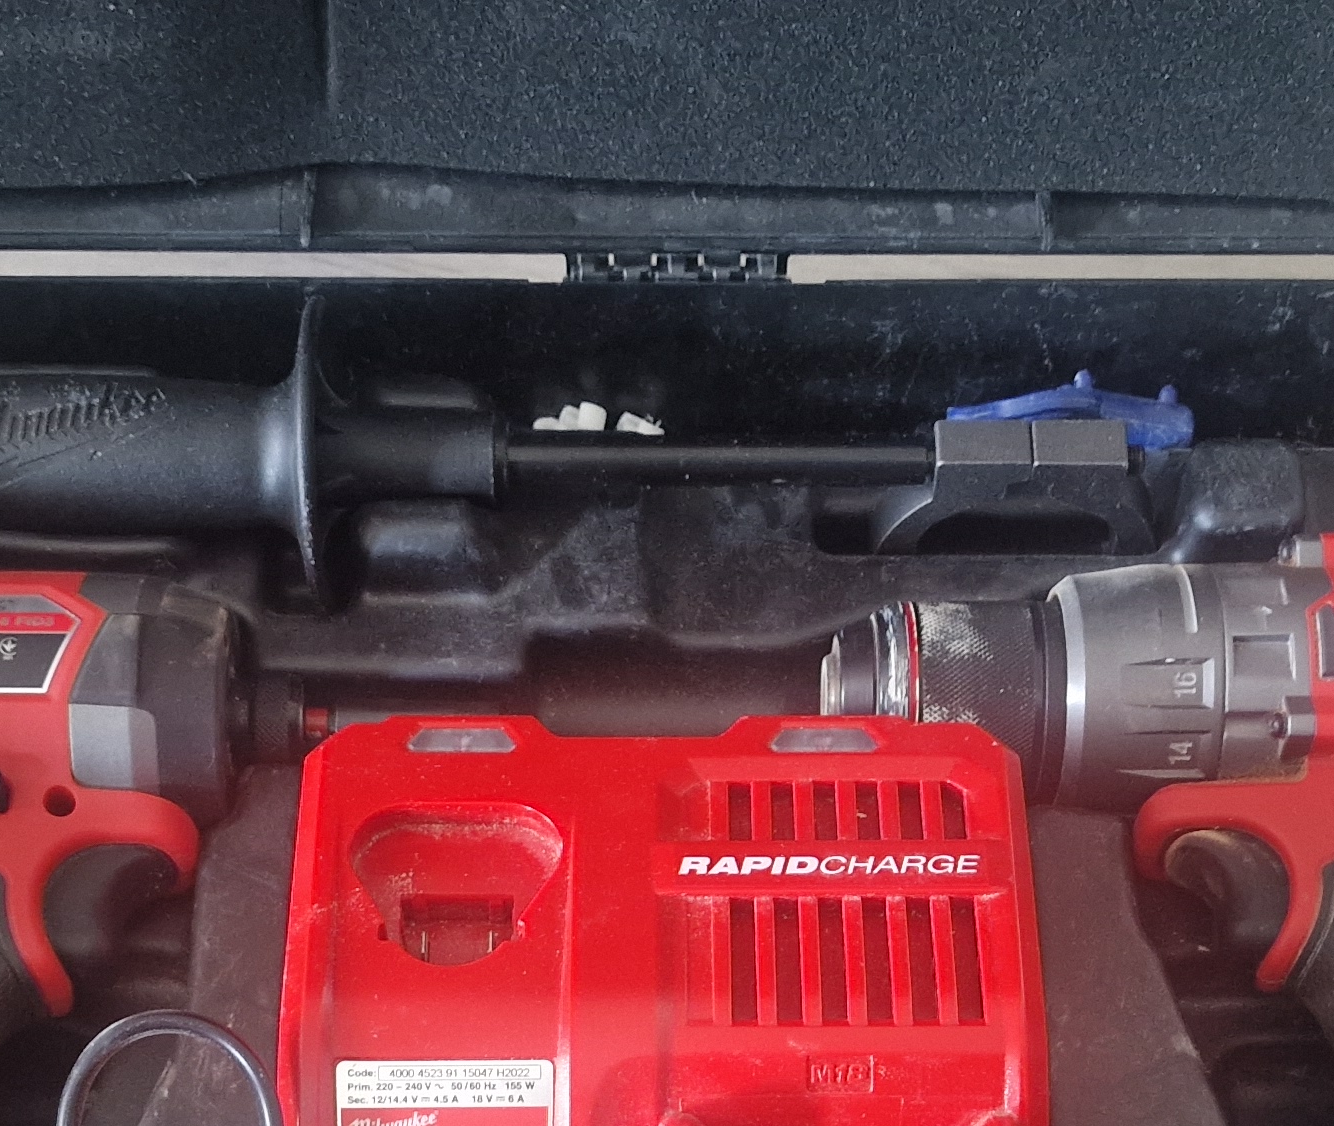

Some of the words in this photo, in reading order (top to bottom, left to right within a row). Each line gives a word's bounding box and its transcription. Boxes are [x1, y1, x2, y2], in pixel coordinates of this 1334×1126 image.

[1174, 671, 1197, 698] 16
[1168, 742, 1193, 765] 14
[678, 855, 981, 875] RAPIDCHARGE
[347, 1069, 376, 1077] Code:
[389, 1068, 415, 1078] 4000
[418, 1068, 443, 1078] 4523
[446, 1068, 458, 1078] 91
[462, 1068, 493, 1077] 15047
[496, 1068, 531, 1077] H2022
[347, 1083, 373, 1091] Prim.
[376, 1083, 394, 1091] 220
[405, 1083, 423, 1091] 240
[424, 1083, 431, 1091] V
[484, 1082, 497, 1090] Hz
[505, 1082, 523, 1090] 155
[525, 1081, 535, 1090] W
[347, 1096, 369, 1105] Sec.
[433, 1095, 449, 1103] 4.5
[451, 1095, 459, 1103] A
[471, 1095, 483, 1103] 18
[486, 1095, 493, 1103] V
[517, 1095, 525, 1103] A
